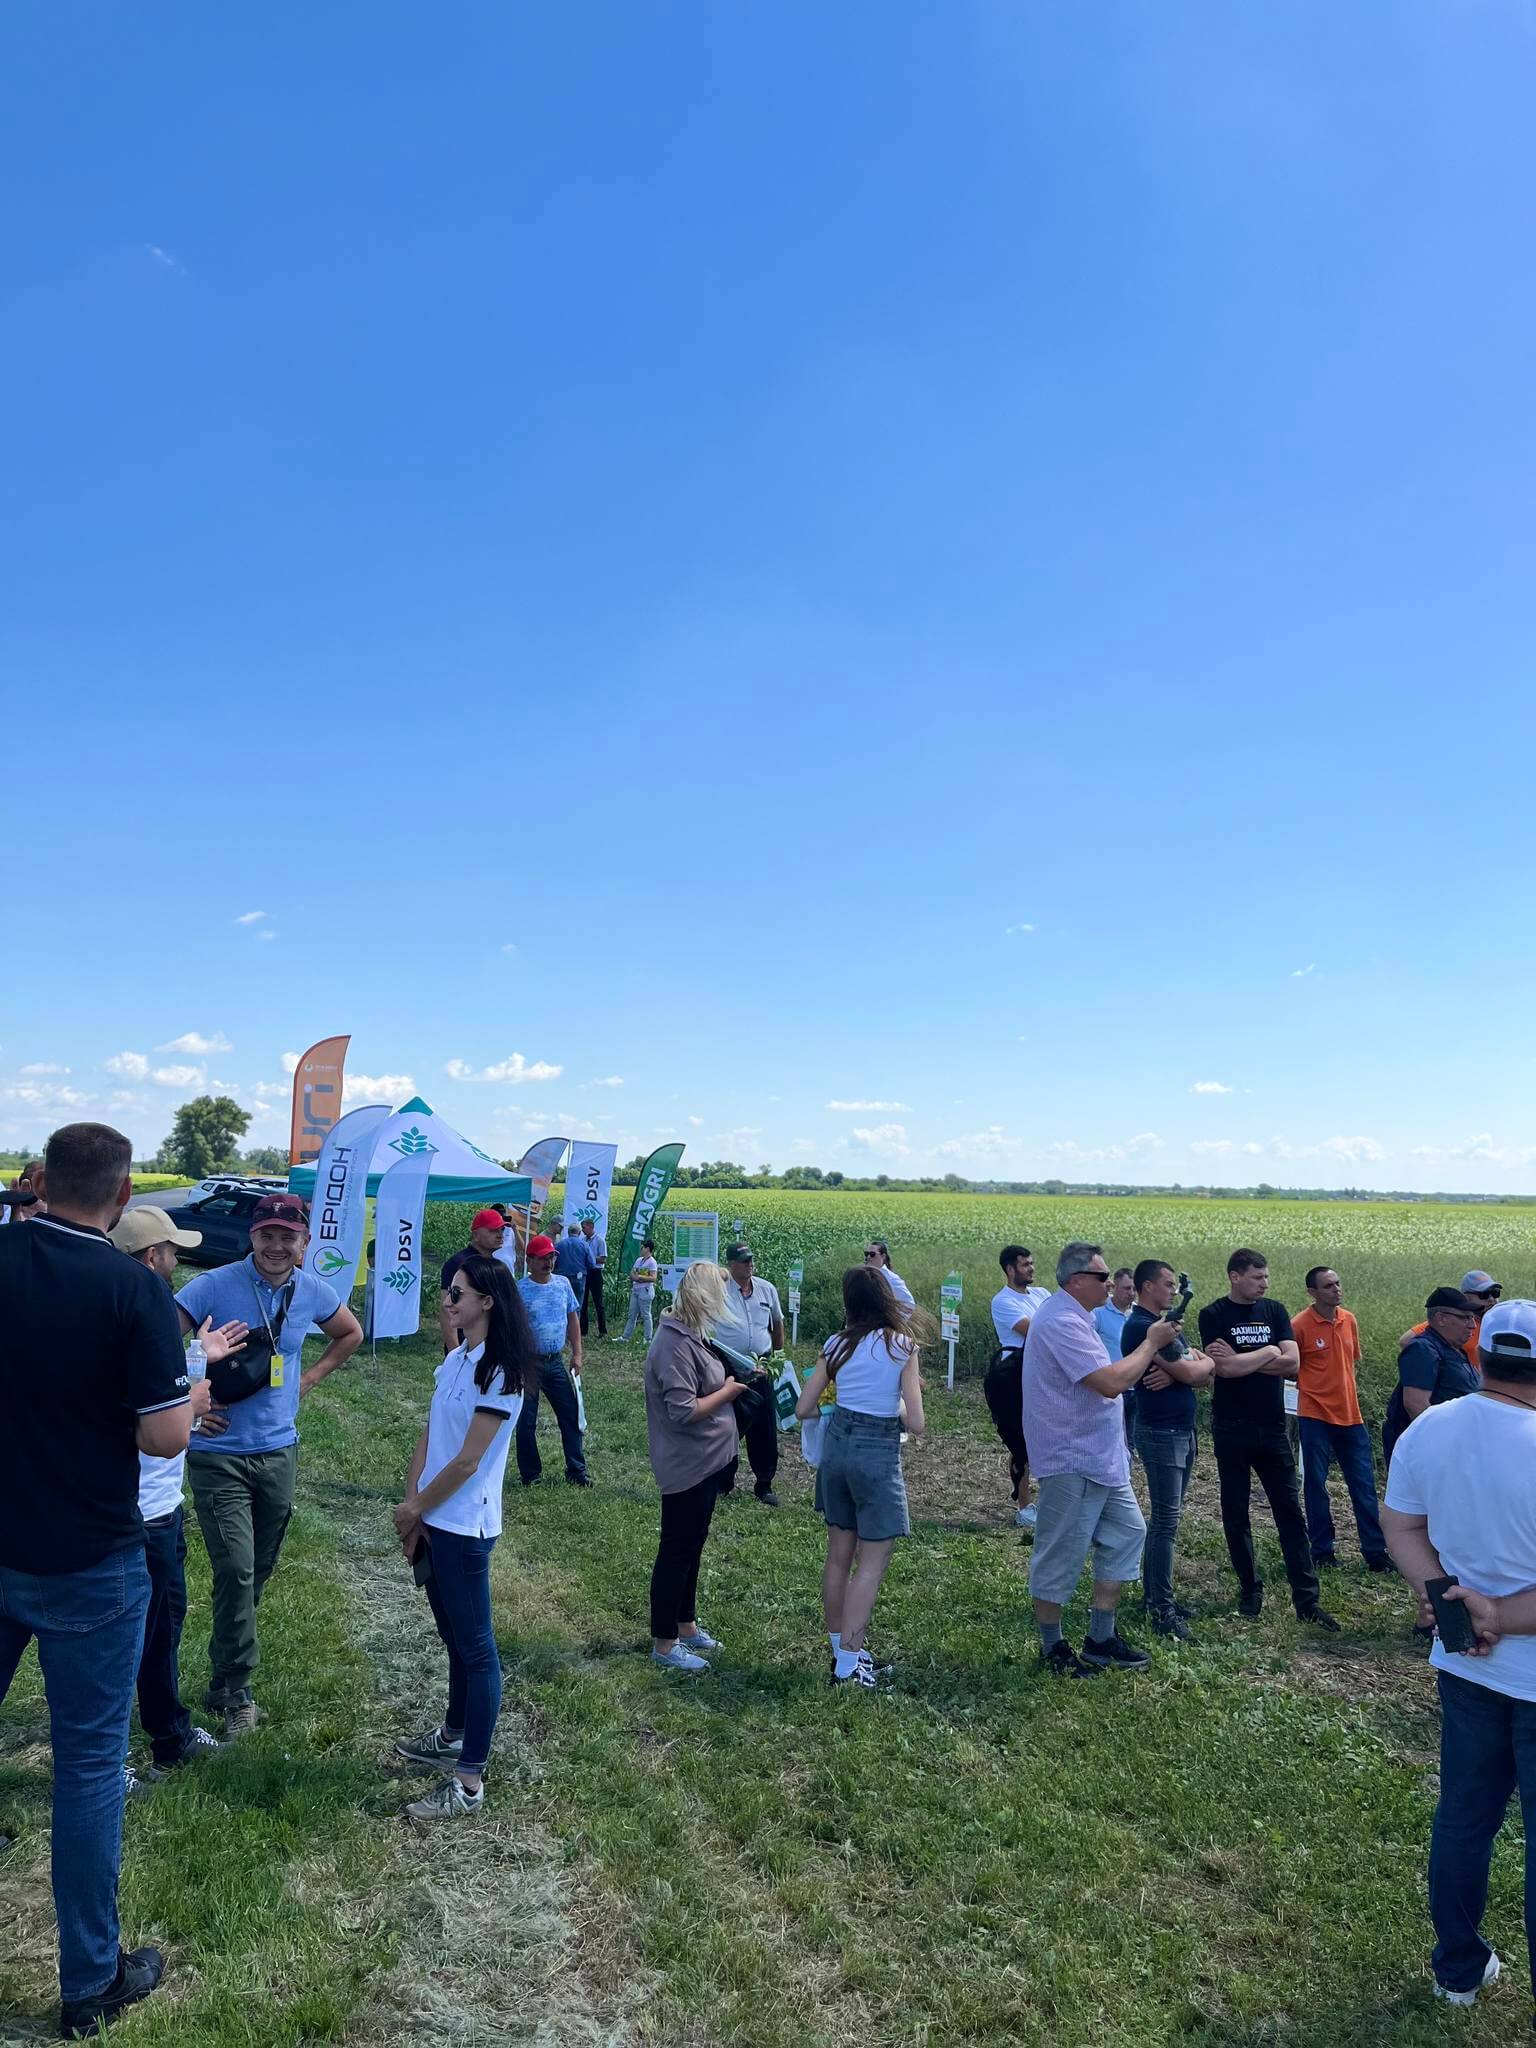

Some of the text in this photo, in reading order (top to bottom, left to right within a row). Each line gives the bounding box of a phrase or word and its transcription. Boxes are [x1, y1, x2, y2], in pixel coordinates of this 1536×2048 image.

[320, 1147, 352, 1240] ЕРІДОН
[586, 1166, 601, 1201] DSV
[631, 1167, 666, 1240] IFAGRI
[398, 1218, 412, 1261] DSV
[1231, 1325, 1270, 1335] ЗАХИЩАЮ
